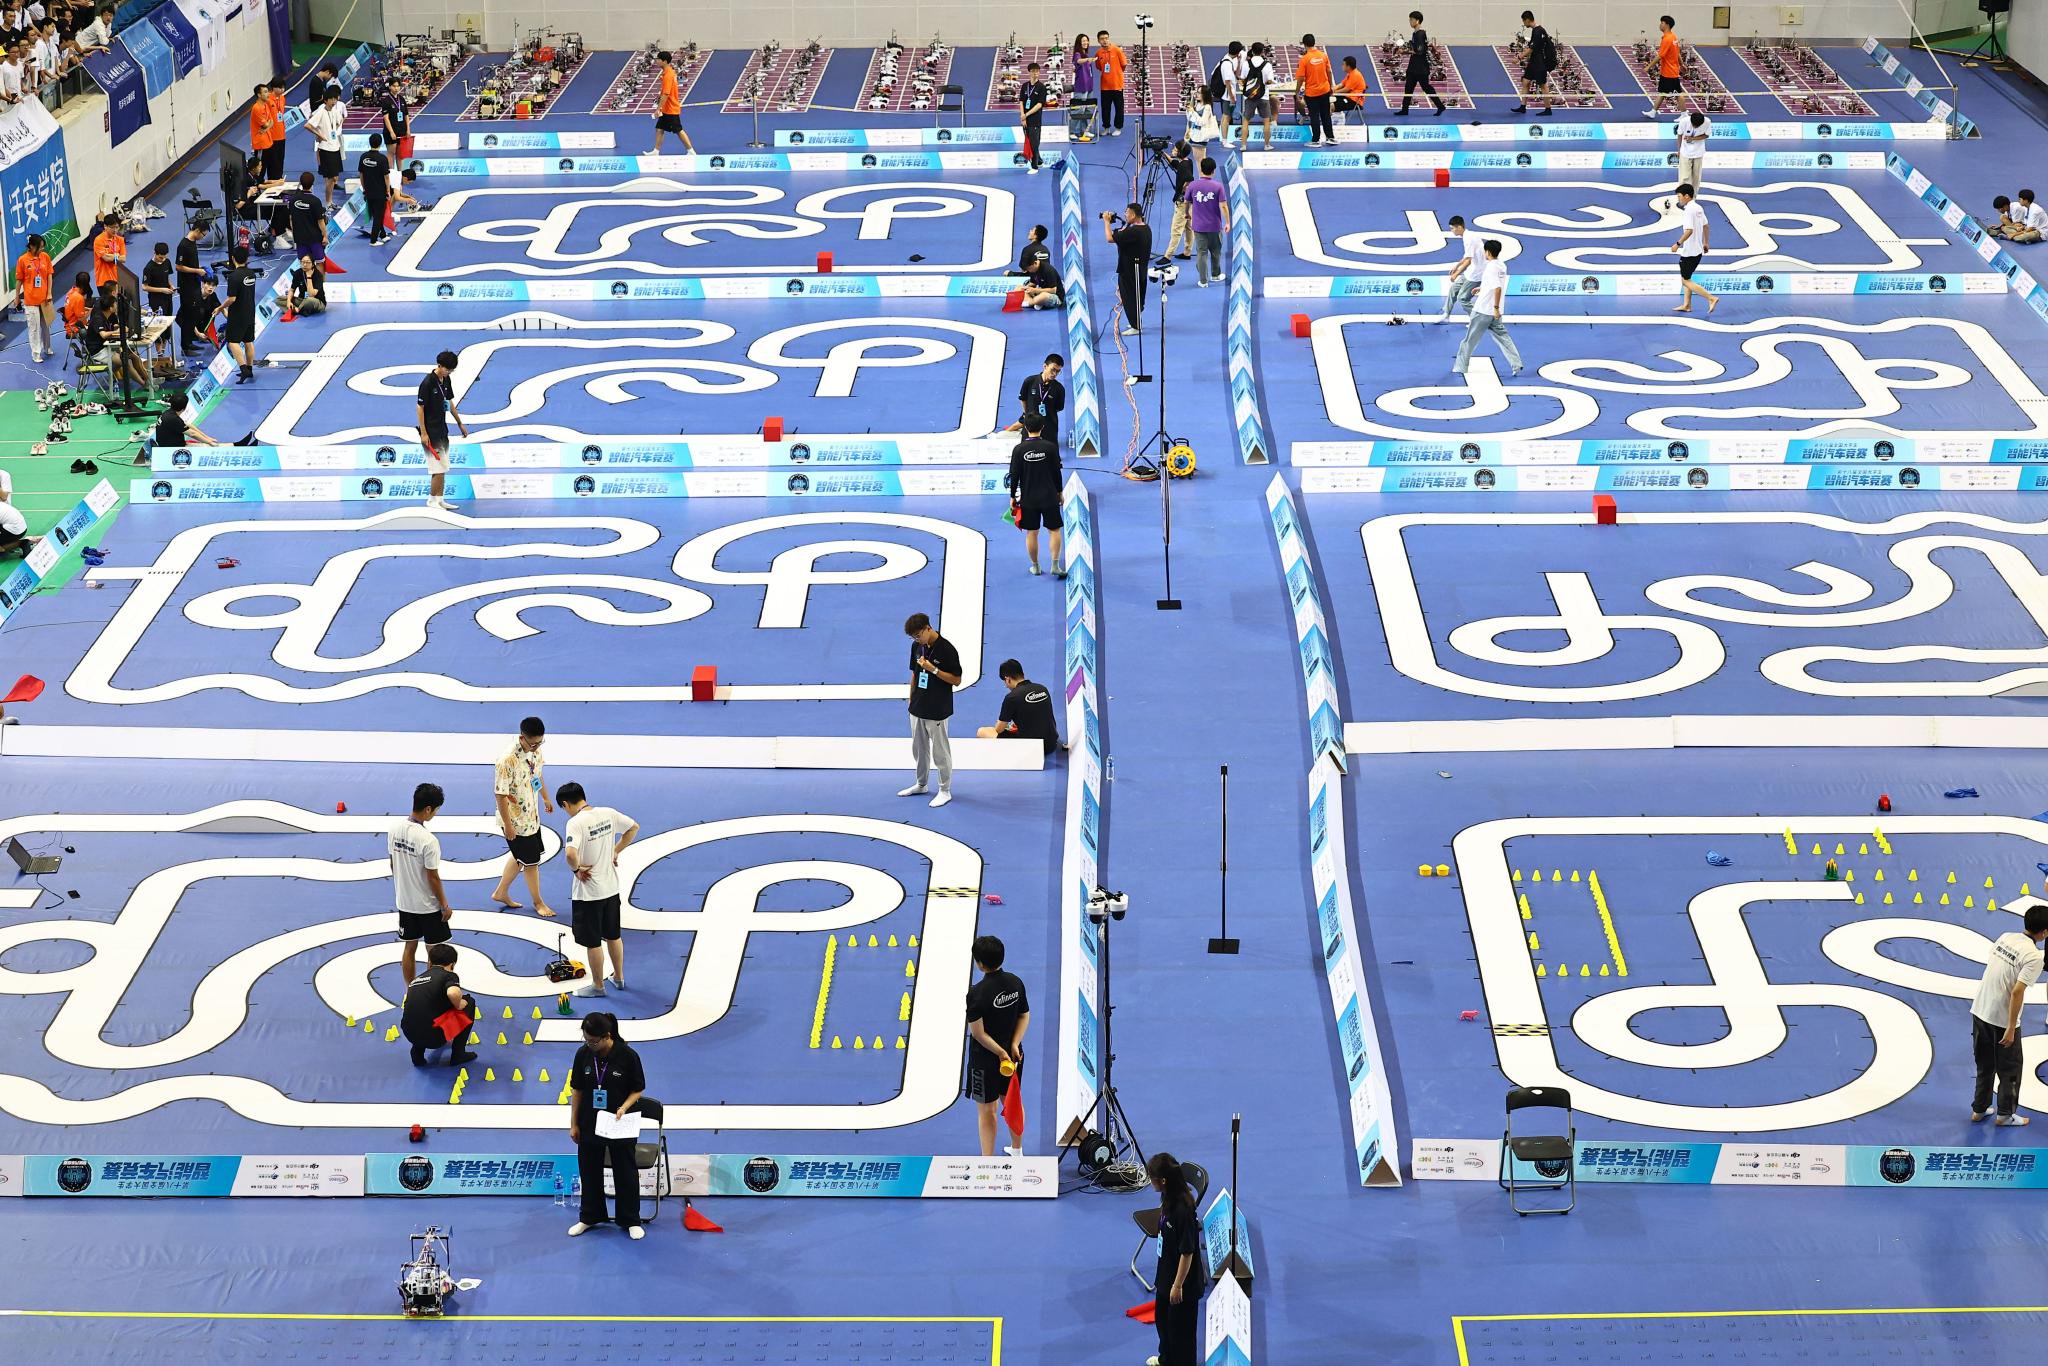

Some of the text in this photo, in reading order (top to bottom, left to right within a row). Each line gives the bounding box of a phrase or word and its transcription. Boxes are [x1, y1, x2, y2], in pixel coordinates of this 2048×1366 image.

[8, 155, 65, 236] 迁安学院
[608, 451, 674, 462] 智能汽车竞赛
[816, 450, 882, 461] 智能汽车竞赛
[1024, 451, 1045, 462] infineon
[1386, 450, 1453, 462] 智能汽车竞赛
[1595, 449, 1662, 460] 智能汽车竞赛
[1802, 448, 1868, 460] 智能汽车竞赛
[198, 455, 263, 466] 智能汽车竞赛
[815, 480, 883, 492] 智能汽车竞赛
[1399, 477, 1468, 488] 智能汽车竞赛
[1612, 476, 1680, 487] 智能汽车竞赛
[1824, 475, 1892, 486] 智能汽车竞赛
[179, 488, 245, 499] 智能汽车竞赛
[601, 483, 668, 494] 智能汽车竞赛
[1025, 691, 1048, 702] infineon
[994, 991, 1018, 1008] infineon
[1579, 1148, 1692, 1167] 智能汽车竞赛
[1924, 1152, 2036, 1172] 智能汽车竞赛
[102, 1162, 211, 1180] 智能汽车竞赛
[443, 1160, 554, 1179] 智能汽车竞赛
[789, 1162, 901, 1180] 智能汽车竞赛
[1596, 1168, 1669, 1176] 第十八届全国大学生
[1942, 1172, 2015, 1181] 第十八届全国大学生
[118, 1181, 190, 1190] 第十八届全国大学生
[460, 1180, 532, 1188] 第十八届全国大学生
[806, 1181, 880, 1190] 第十八届全国大学生
